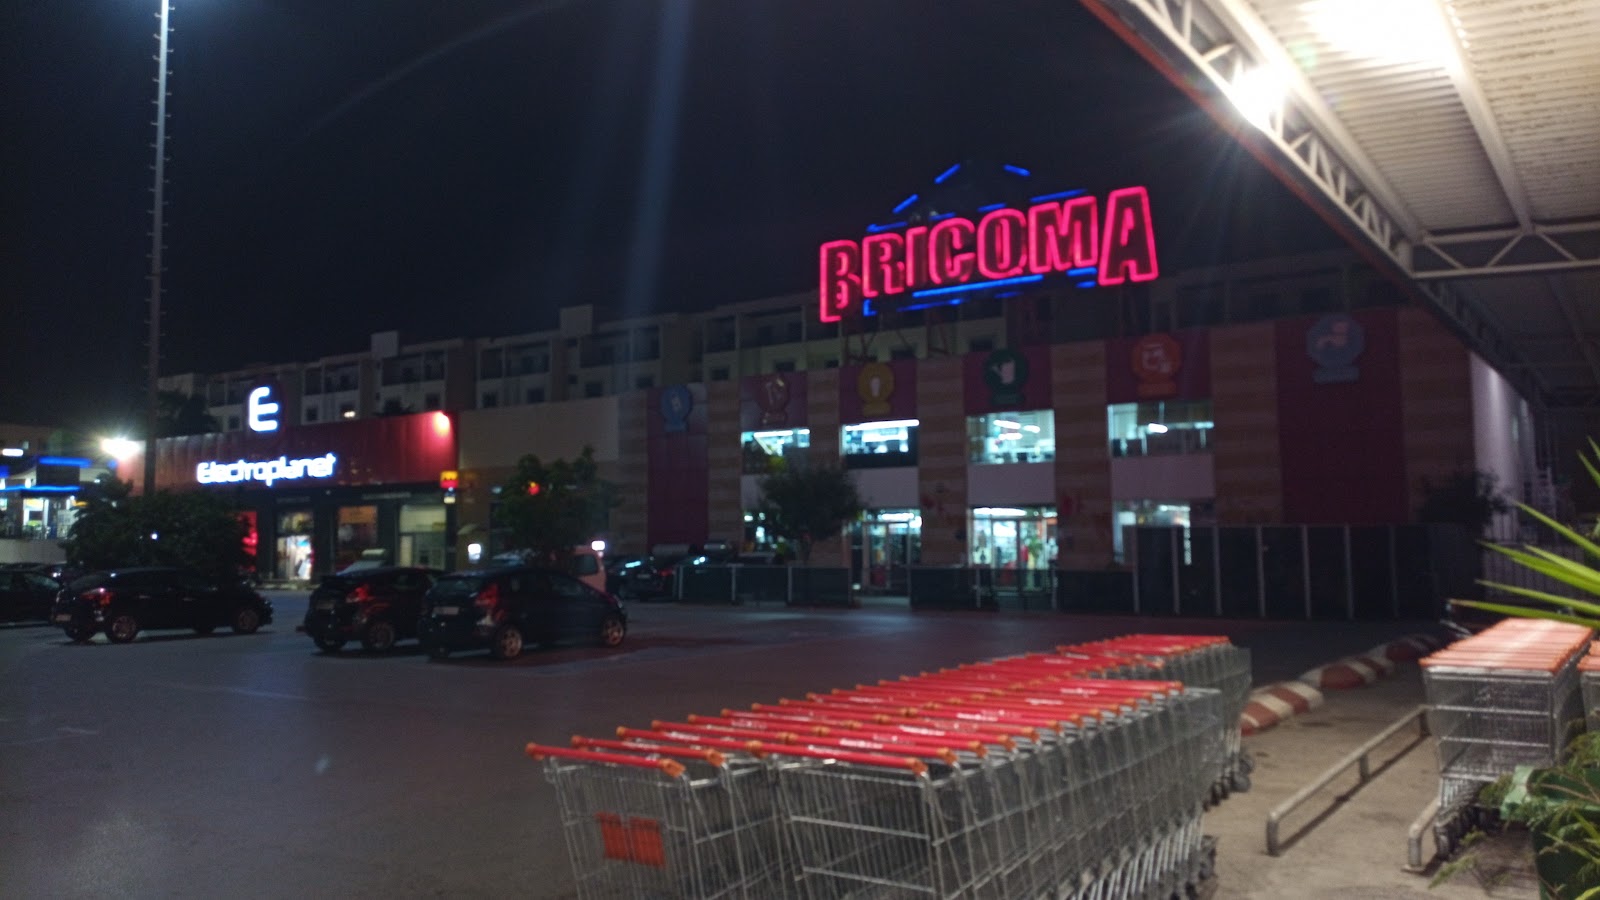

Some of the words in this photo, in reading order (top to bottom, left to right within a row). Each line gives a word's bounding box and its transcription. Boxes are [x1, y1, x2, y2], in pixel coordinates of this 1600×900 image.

[819, 185, 1159, 323] BRICOMA
[249, 386, 279, 432] E
[197, 453, 337, 486] Electroplanet
